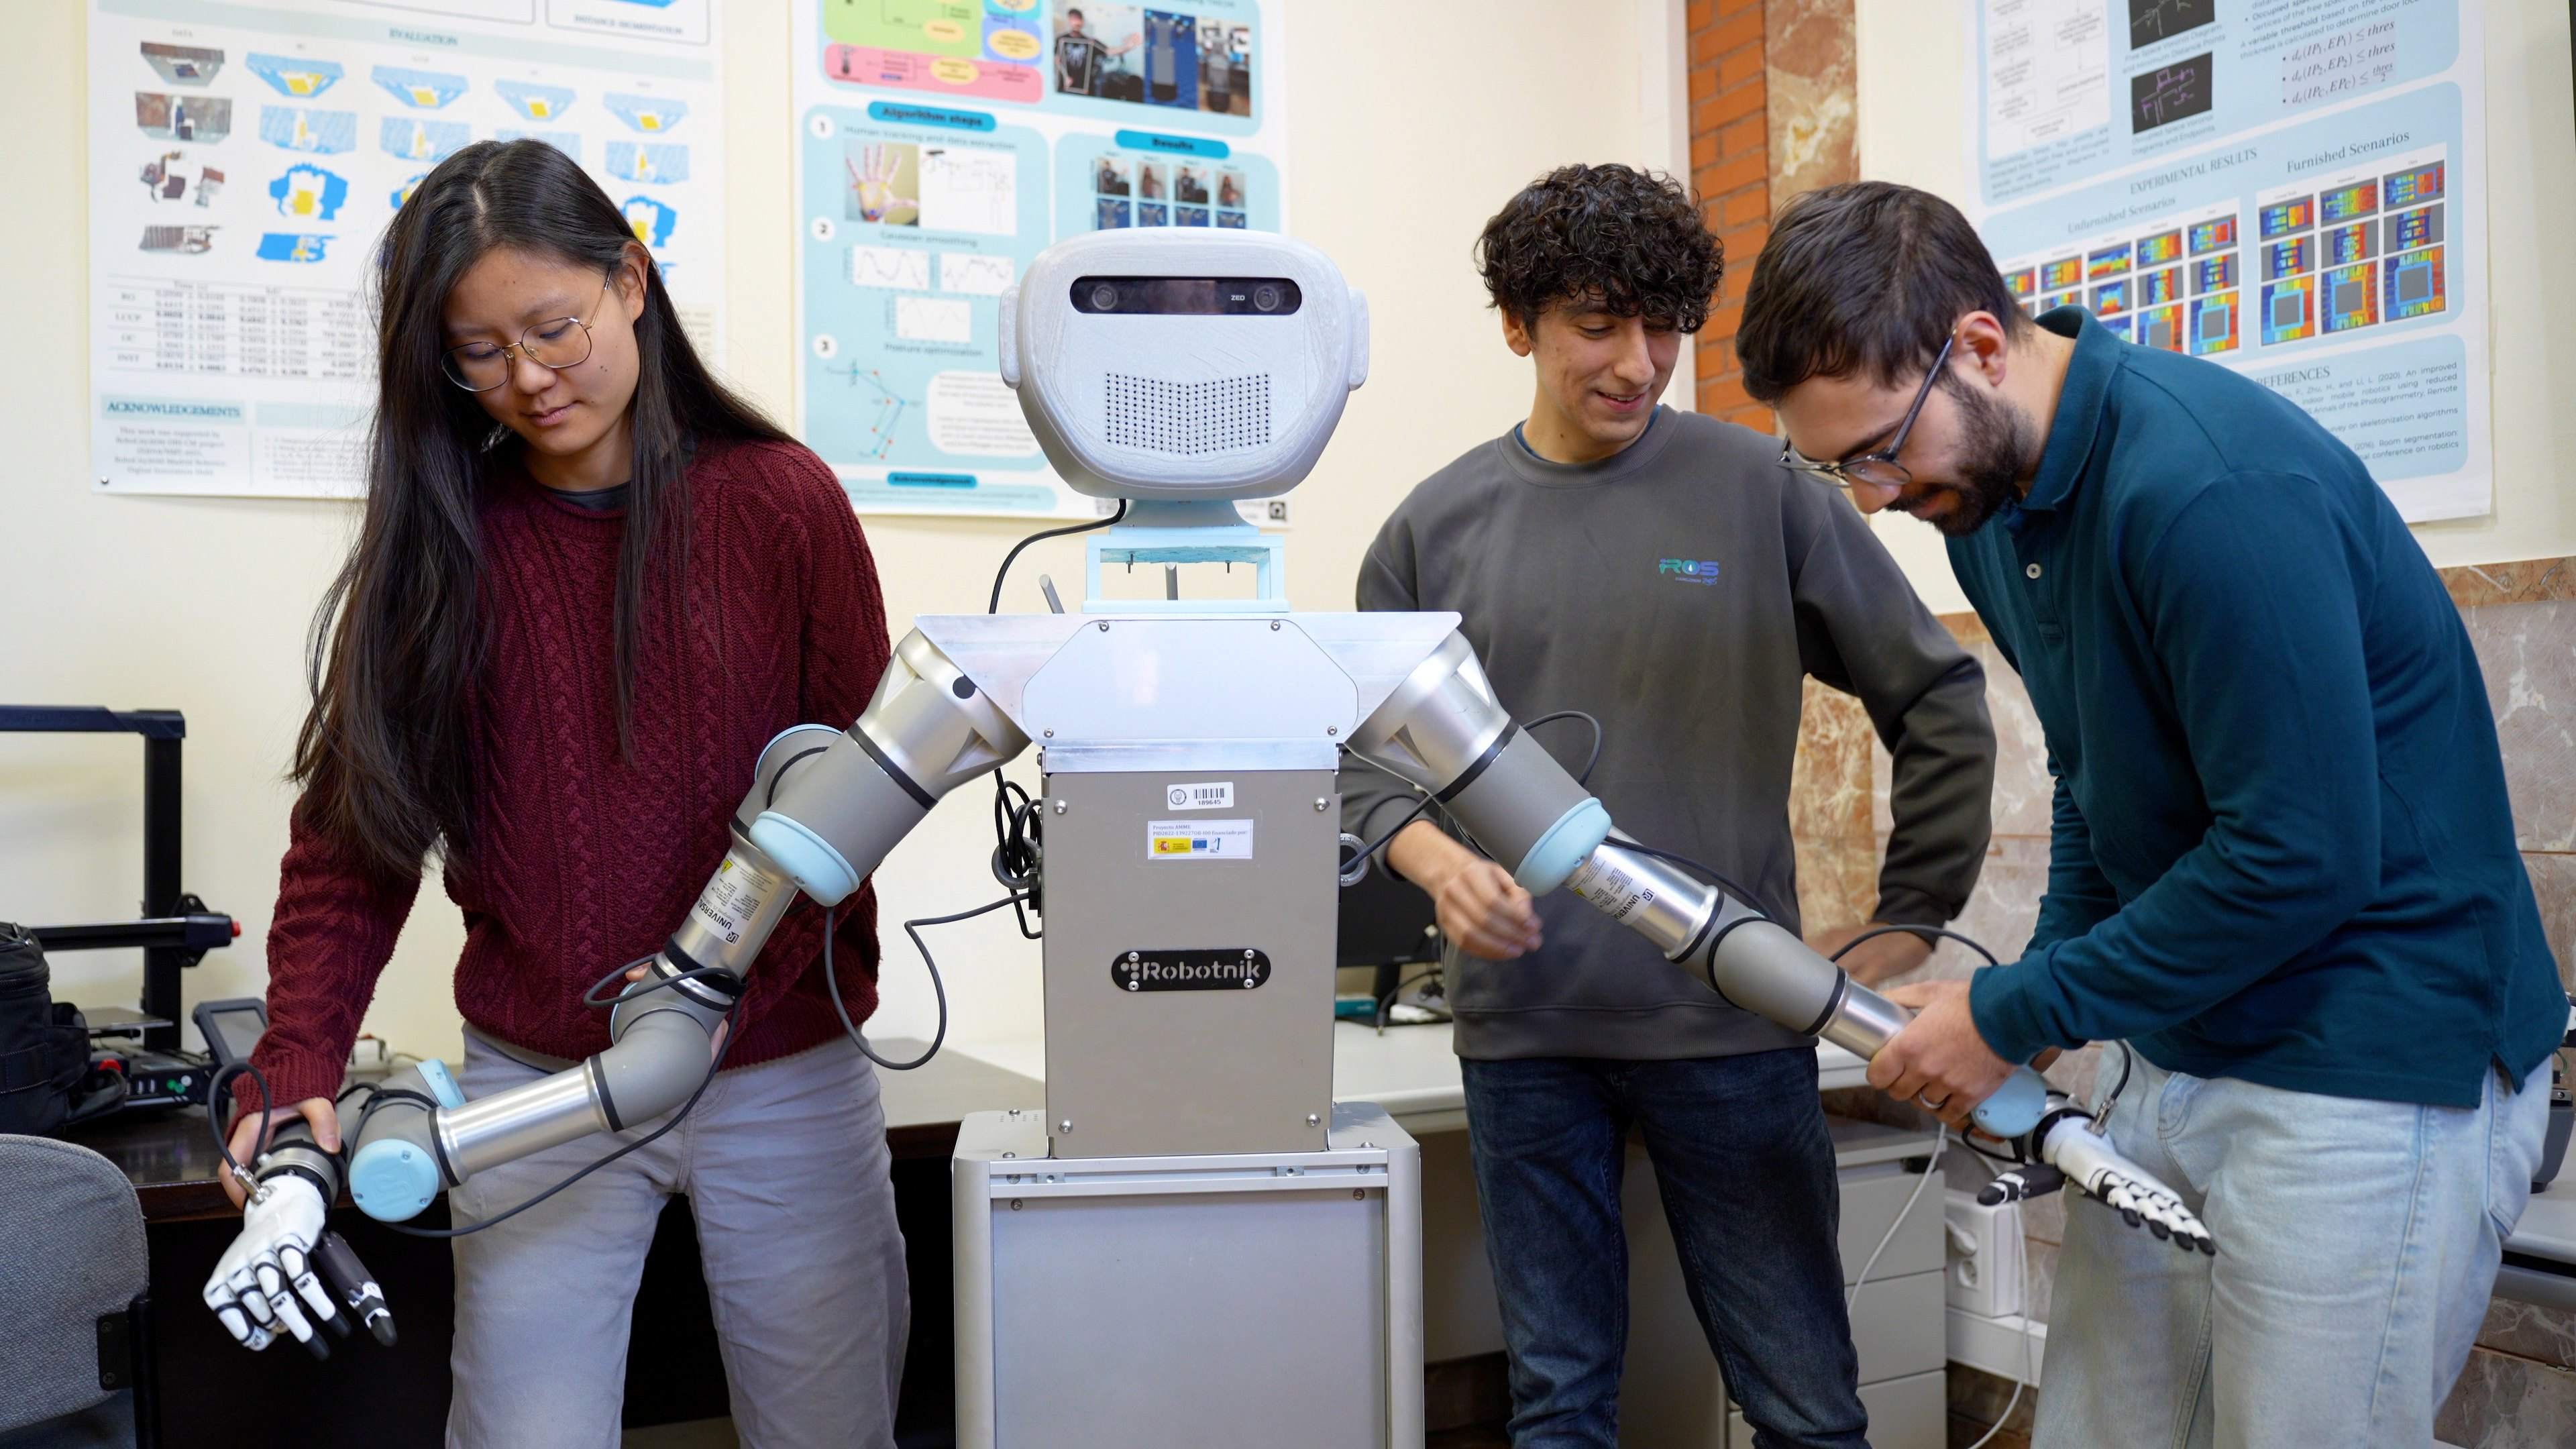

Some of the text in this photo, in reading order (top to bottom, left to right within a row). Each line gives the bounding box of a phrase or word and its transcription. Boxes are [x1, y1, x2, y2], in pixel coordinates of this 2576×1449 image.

[2281, 15, 2318, 35] threshold
[2320, 7, 2345, 21] based
[2348, 3, 2359, 12] on
[2285, 28, 2324, 44] calculated
[2326, 23, 2334, 32] to
[2336, 9, 2379, 28] determine
[2381, 1, 2400, 13] door
[2368, 21, 2395, 36] thres
[389, 26, 459, 46] EVALUATION
[2368, 43, 2396, 58] thres
[883, 107, 984, 127] Algorithm steps
[845, 125, 879, 136] Human
[883, 130, 924, 142] tracking
[926, 135, 944, 143] and
[1152, 137, 1194, 152] Results
[2287, 131, 2410, 173] Furnished Scenarios
[2130, 147, 2258, 195] EXPERIMENTAL RESULTS
[820, 222, 828, 235] 2
[926, 235, 978, 248] smoothing
[2339, 380, 2352, 388] and
[2406, 370, 2416, 378] An
[2421, 362, 2457, 375] improved
[2330, 390, 2355, 400] mobile
[2362, 385, 2391, 395] robotics
[2398, 380, 2418, 390] using
[2426, 373, 2457, 385] reduced
[2347, 399, 2359, 408] the
[2361, 390, 2425, 407] Photogrammetry,
[2428, 384, 2458, 396] Remote
[107, 400, 241, 417] ACKNOWLEDGEMENTS
[2360, 413, 2415, 429] skeletonization
[2417, 407, 2459, 420] algorithms
[2379, 438, 2401, 447] Room
[2404, 430, 2459, 444] segmentation:
[2372, 446, 2414, 460] conference
[2416, 445, 2426, 453] on
[2428, 440, 2459, 451] robotics
[1142, 960, 1260, 980] Robotnik
